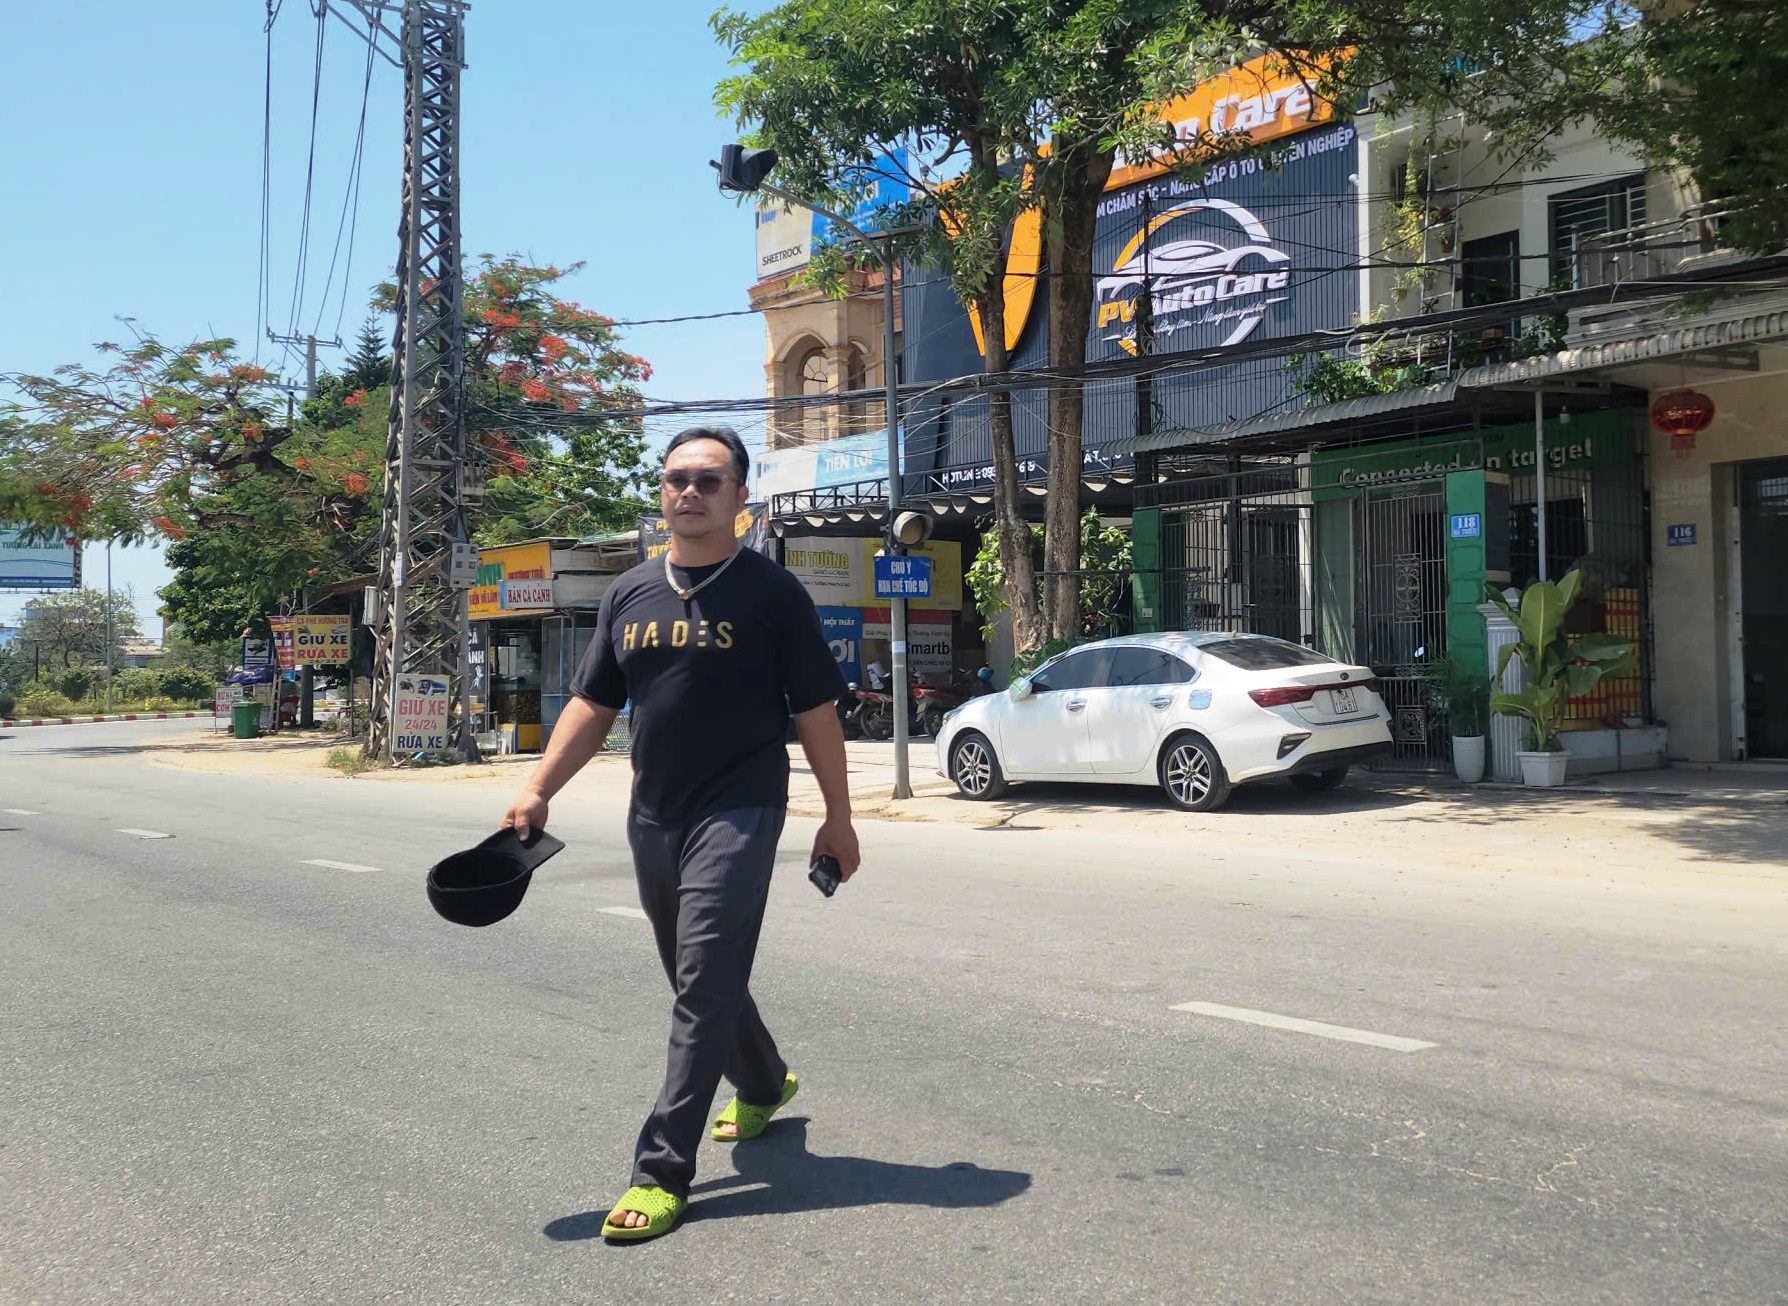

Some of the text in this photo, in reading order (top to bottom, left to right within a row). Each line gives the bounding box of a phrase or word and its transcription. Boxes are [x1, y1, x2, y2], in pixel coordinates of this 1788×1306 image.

[1107, 191, 1136, 214] CHĂM
[1308, 126, 1355, 156] NGHIỆP
[762, 244, 802, 267] SHEETROCK
[1457, 516, 1476, 529] 118
[1674, 527, 1692, 538] 116
[890, 558, 905, 575] CHÚ
[904, 576, 918, 593] TỐC
[507, 585, 521, 603] BÁN
[522, 585, 532, 603] CÁ
[298, 632, 348, 645] GIỮ XE
[622, 620, 734, 651] HADES
[297, 646, 326, 659] RỬA
[331, 648, 348, 659] XE
[398, 696, 446, 716] GIỮ XE
[404, 719, 438, 731] 24/24
[397, 731, 443, 749] RỬA XE
